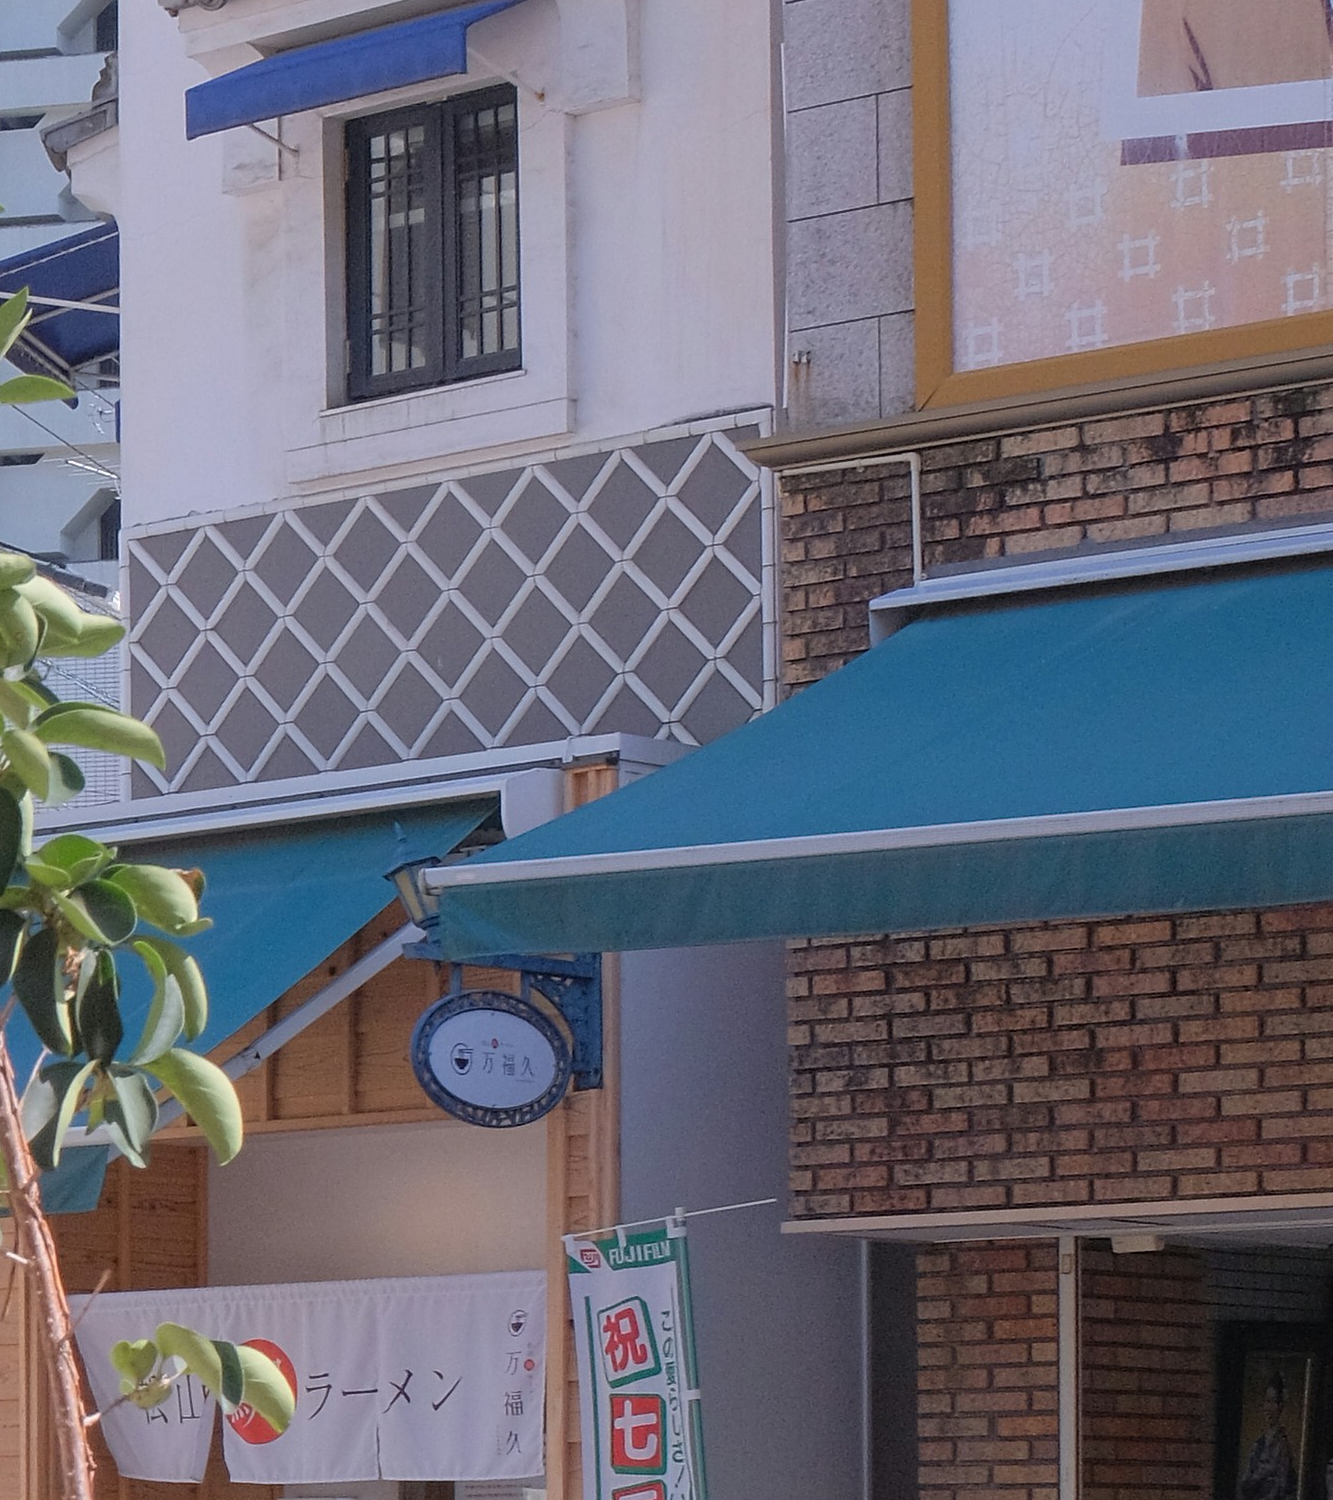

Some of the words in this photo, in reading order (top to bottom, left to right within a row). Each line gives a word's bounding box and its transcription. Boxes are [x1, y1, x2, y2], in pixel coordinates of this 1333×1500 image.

[482, 1052, 535, 1077] 万福久
[505, 1351, 524, 1455] 万福久
